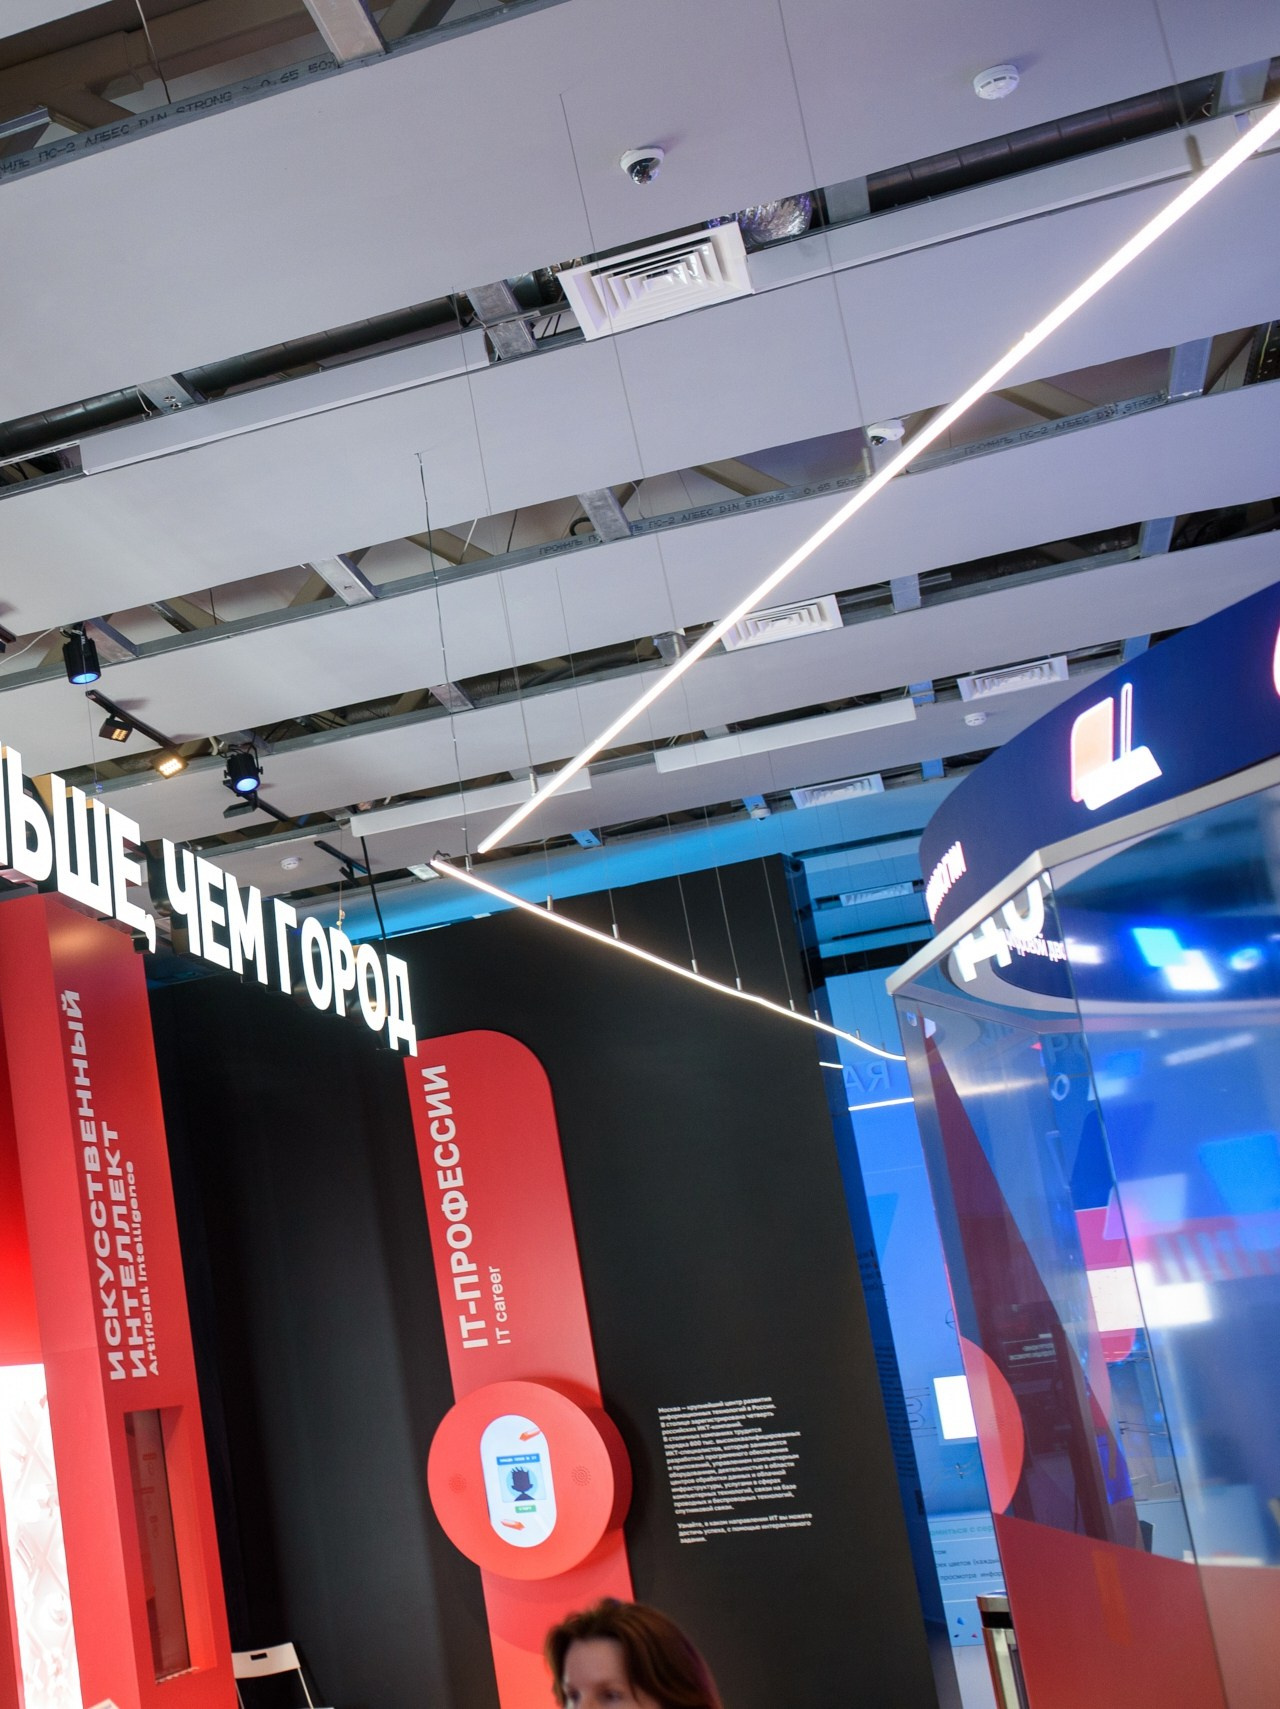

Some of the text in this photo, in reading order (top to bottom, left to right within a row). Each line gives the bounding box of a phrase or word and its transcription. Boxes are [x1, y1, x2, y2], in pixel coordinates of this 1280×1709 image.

[39, 142, 76, 162] ПС-2
[85, 124, 130, 147] АЛБЕС
[176, 91, 233, 113] STRONG
[648, 517, 675, 528] ПС-2
[681, 508, 713, 521] АЛБЕС
[719, 503, 740, 515] DIN
[745, 493, 785, 508] STRONG
[1019, 426, 1048, 441] ПС-2
[1054, 415, 1090, 431] АЛБЕС
[161, 838, 269, 985] ЧЕМ
[273, 897, 418, 1057] ГОРОД
[60, 990, 127, 1380] ИСКУССТВЕННЫЙ
[101, 1121, 148, 1379] ИНТЕЛЛЕКТ
[124, 1160, 160, 1377] Artificial Intelligence
[421, 1064, 489, 1349] IT-ПРОФЕССИИ
[488, 1266, 512, 1345] IT career
